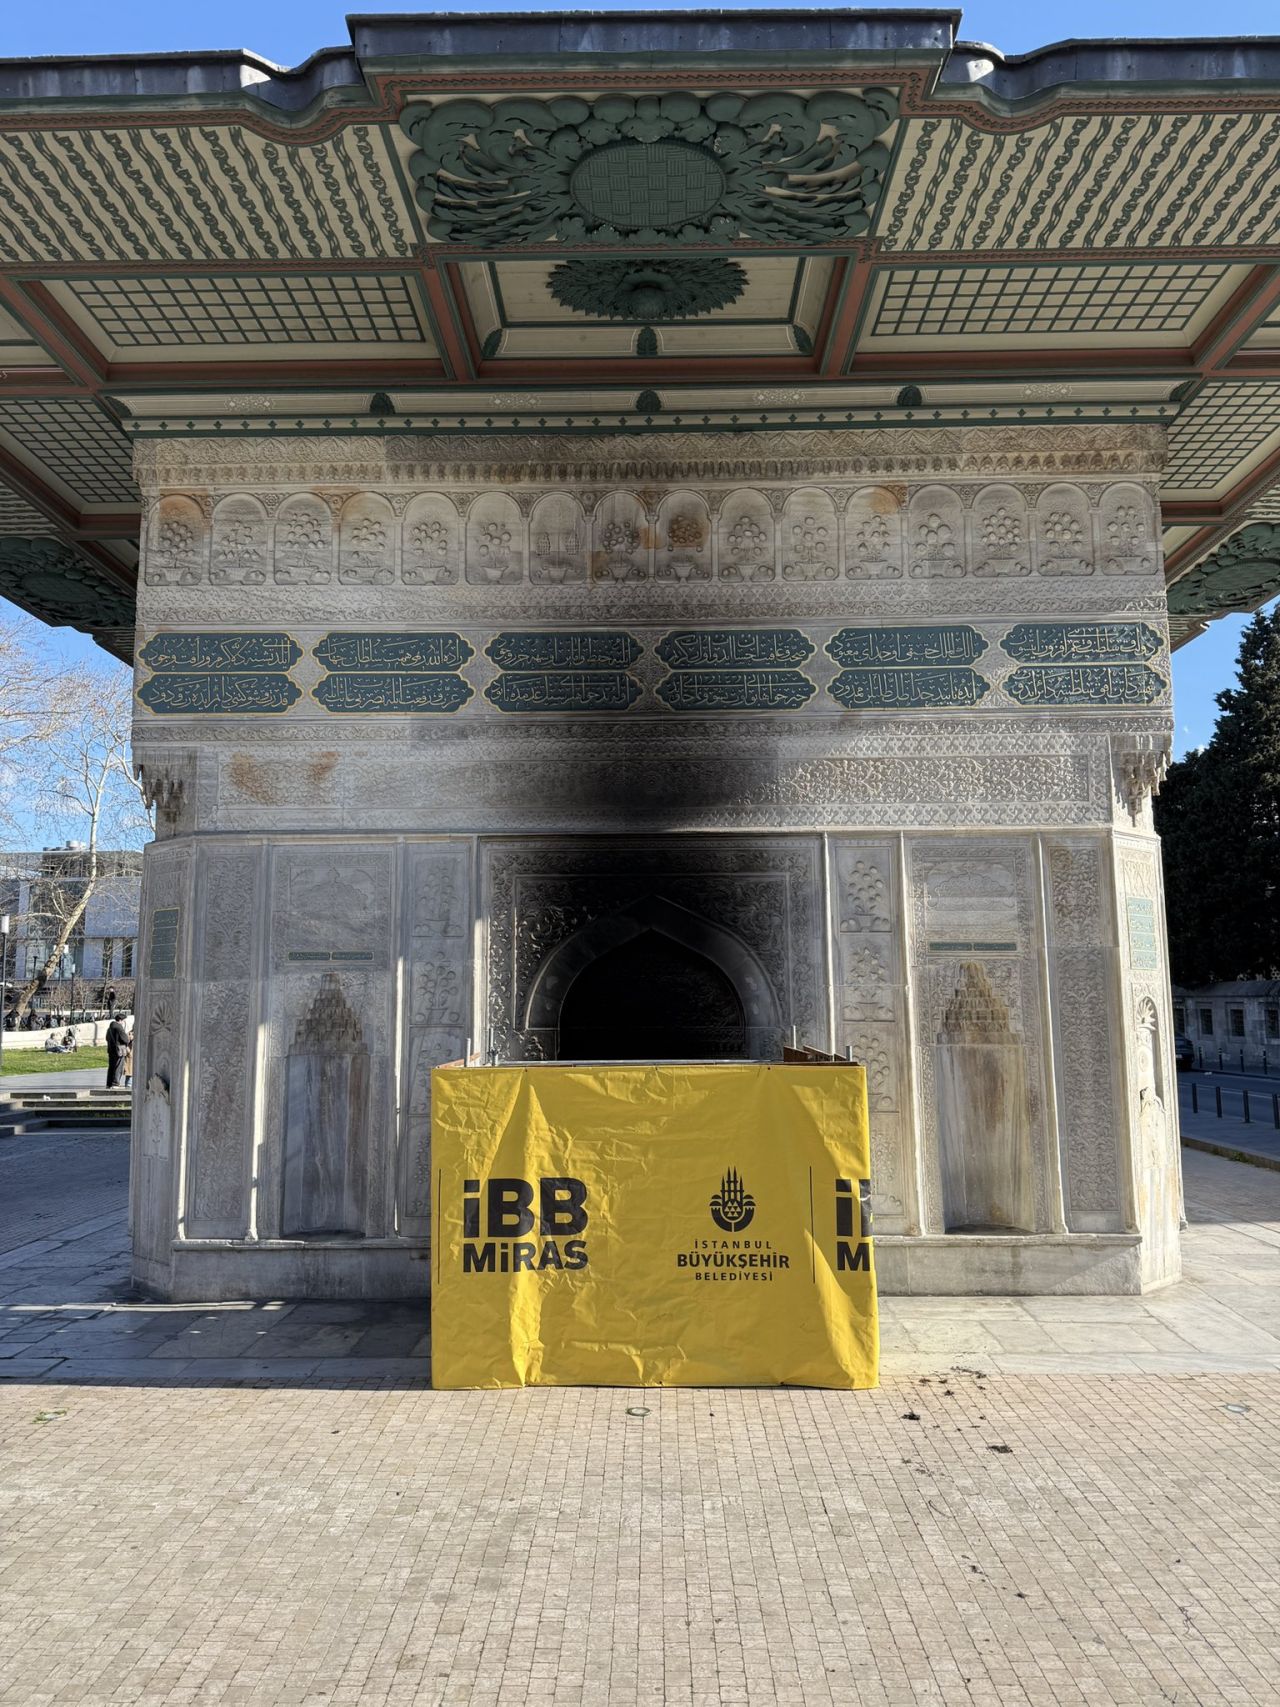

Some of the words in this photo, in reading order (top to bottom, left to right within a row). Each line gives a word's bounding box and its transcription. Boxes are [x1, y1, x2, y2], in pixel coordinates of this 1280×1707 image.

[835, 1178, 873, 1237] i
[694, 1239, 772, 1249] İSTANBUL
[677, 1251, 790, 1269] BÜYÜKŞEHİR
[695, 1271, 773, 1281] BELEDİYESİ
